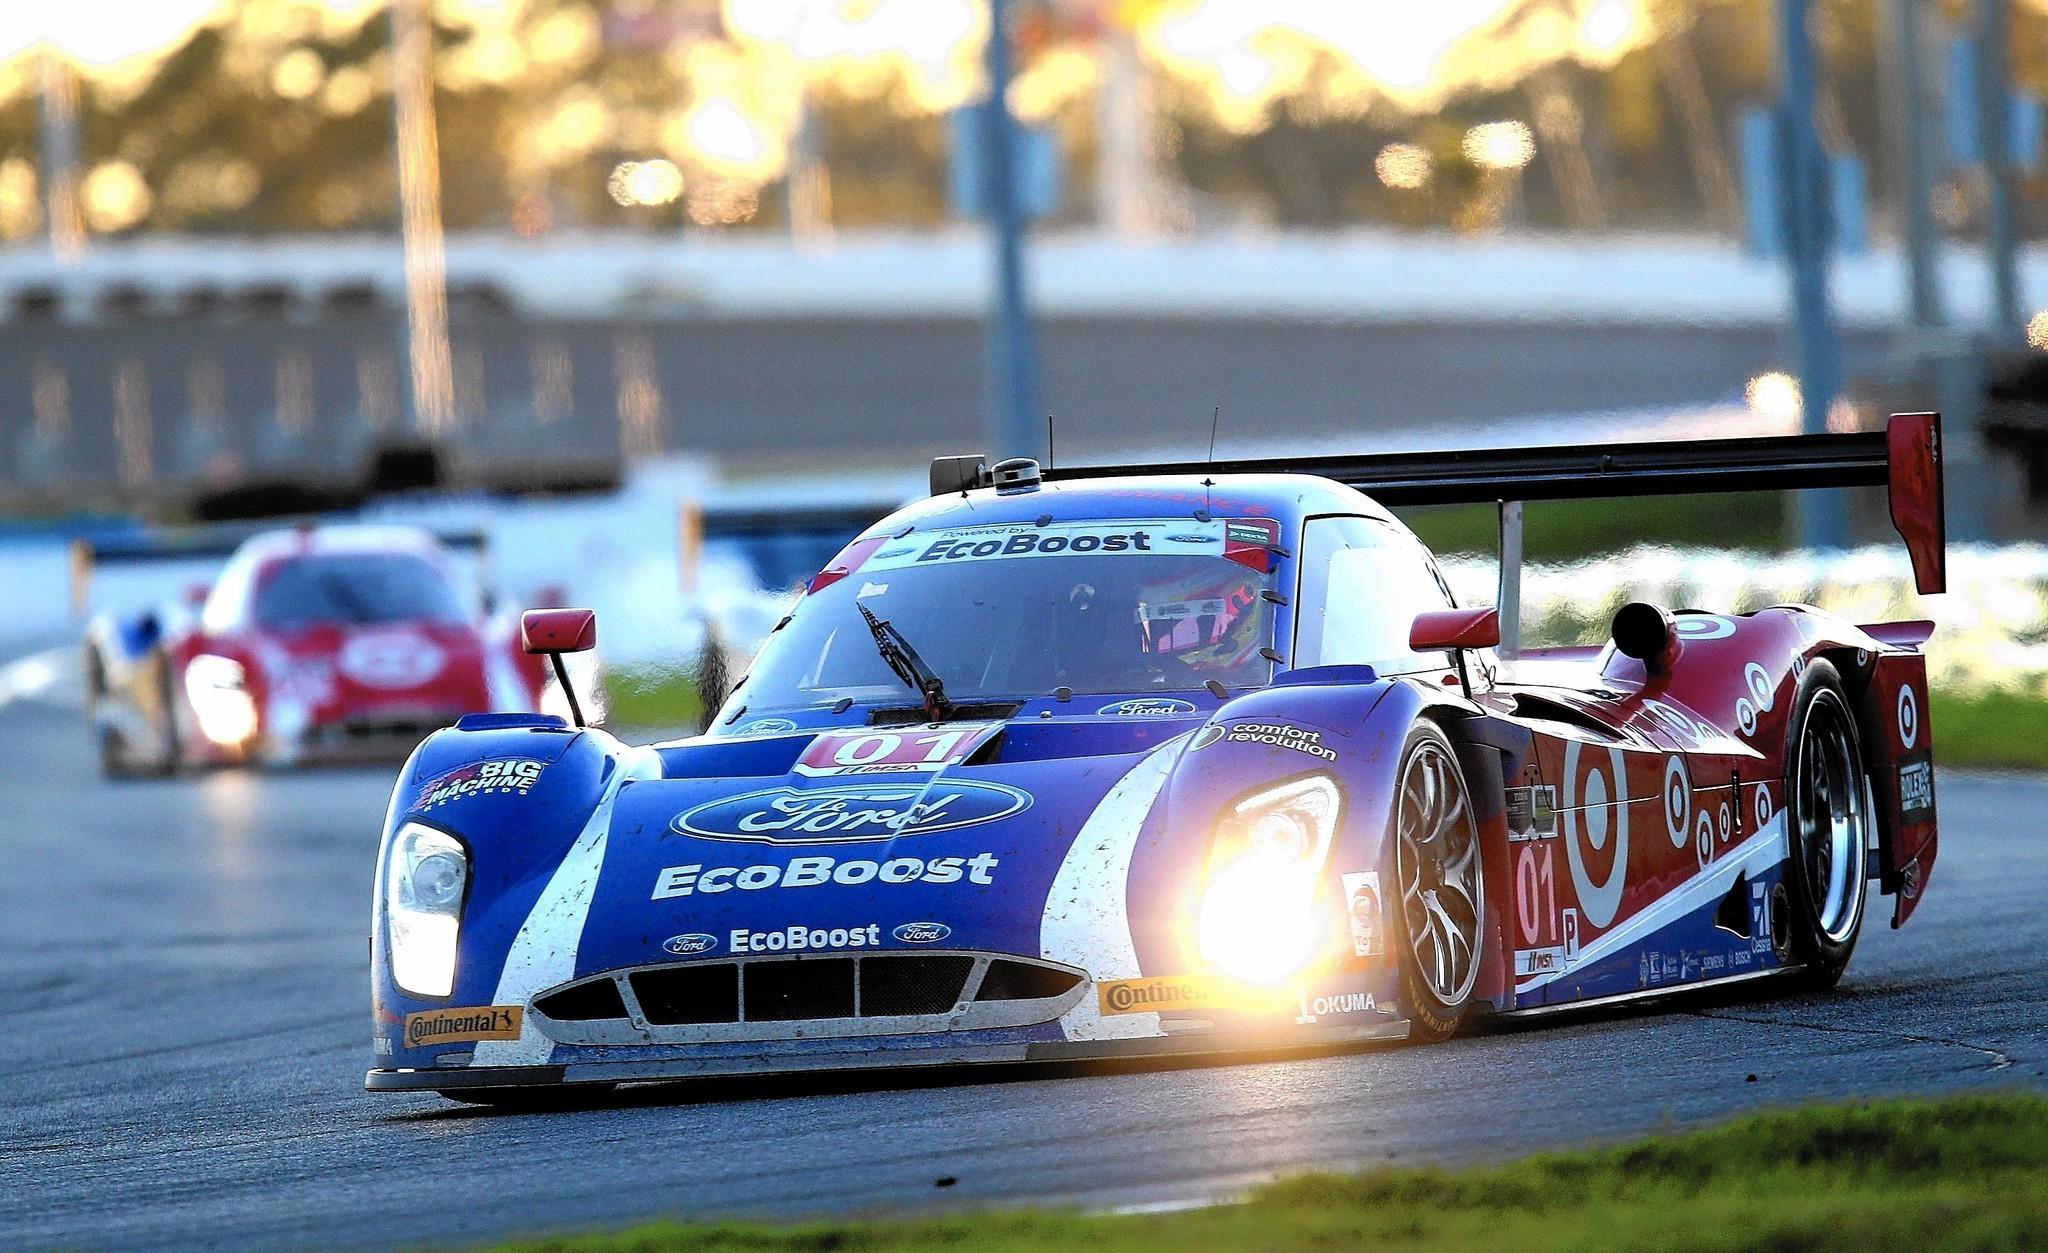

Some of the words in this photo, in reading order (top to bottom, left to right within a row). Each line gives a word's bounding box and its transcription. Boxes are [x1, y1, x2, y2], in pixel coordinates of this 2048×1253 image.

[915, 531, 1151, 562] EcoBoost
[1118, 701, 1178, 715] Ford
[1226, 731, 1337, 761] revolution
[1232, 723, 1321, 743] comfort
[833, 732, 967, 766] 01
[480, 761, 543, 777] BIG
[427, 775, 537, 804] MACHINE
[738, 793, 964, 833] Ford
[650, 853, 1000, 900] EcoBoost
[1516, 844, 1557, 946] 01
[672, 936, 707, 952] Ford
[729, 924, 881, 952] EcoBoost
[903, 924, 941, 940] Ford
[1565, 913, 1576, 956] P
[1313, 992, 1377, 1015] OKUMA
[409, 1010, 497, 1045] Continental
